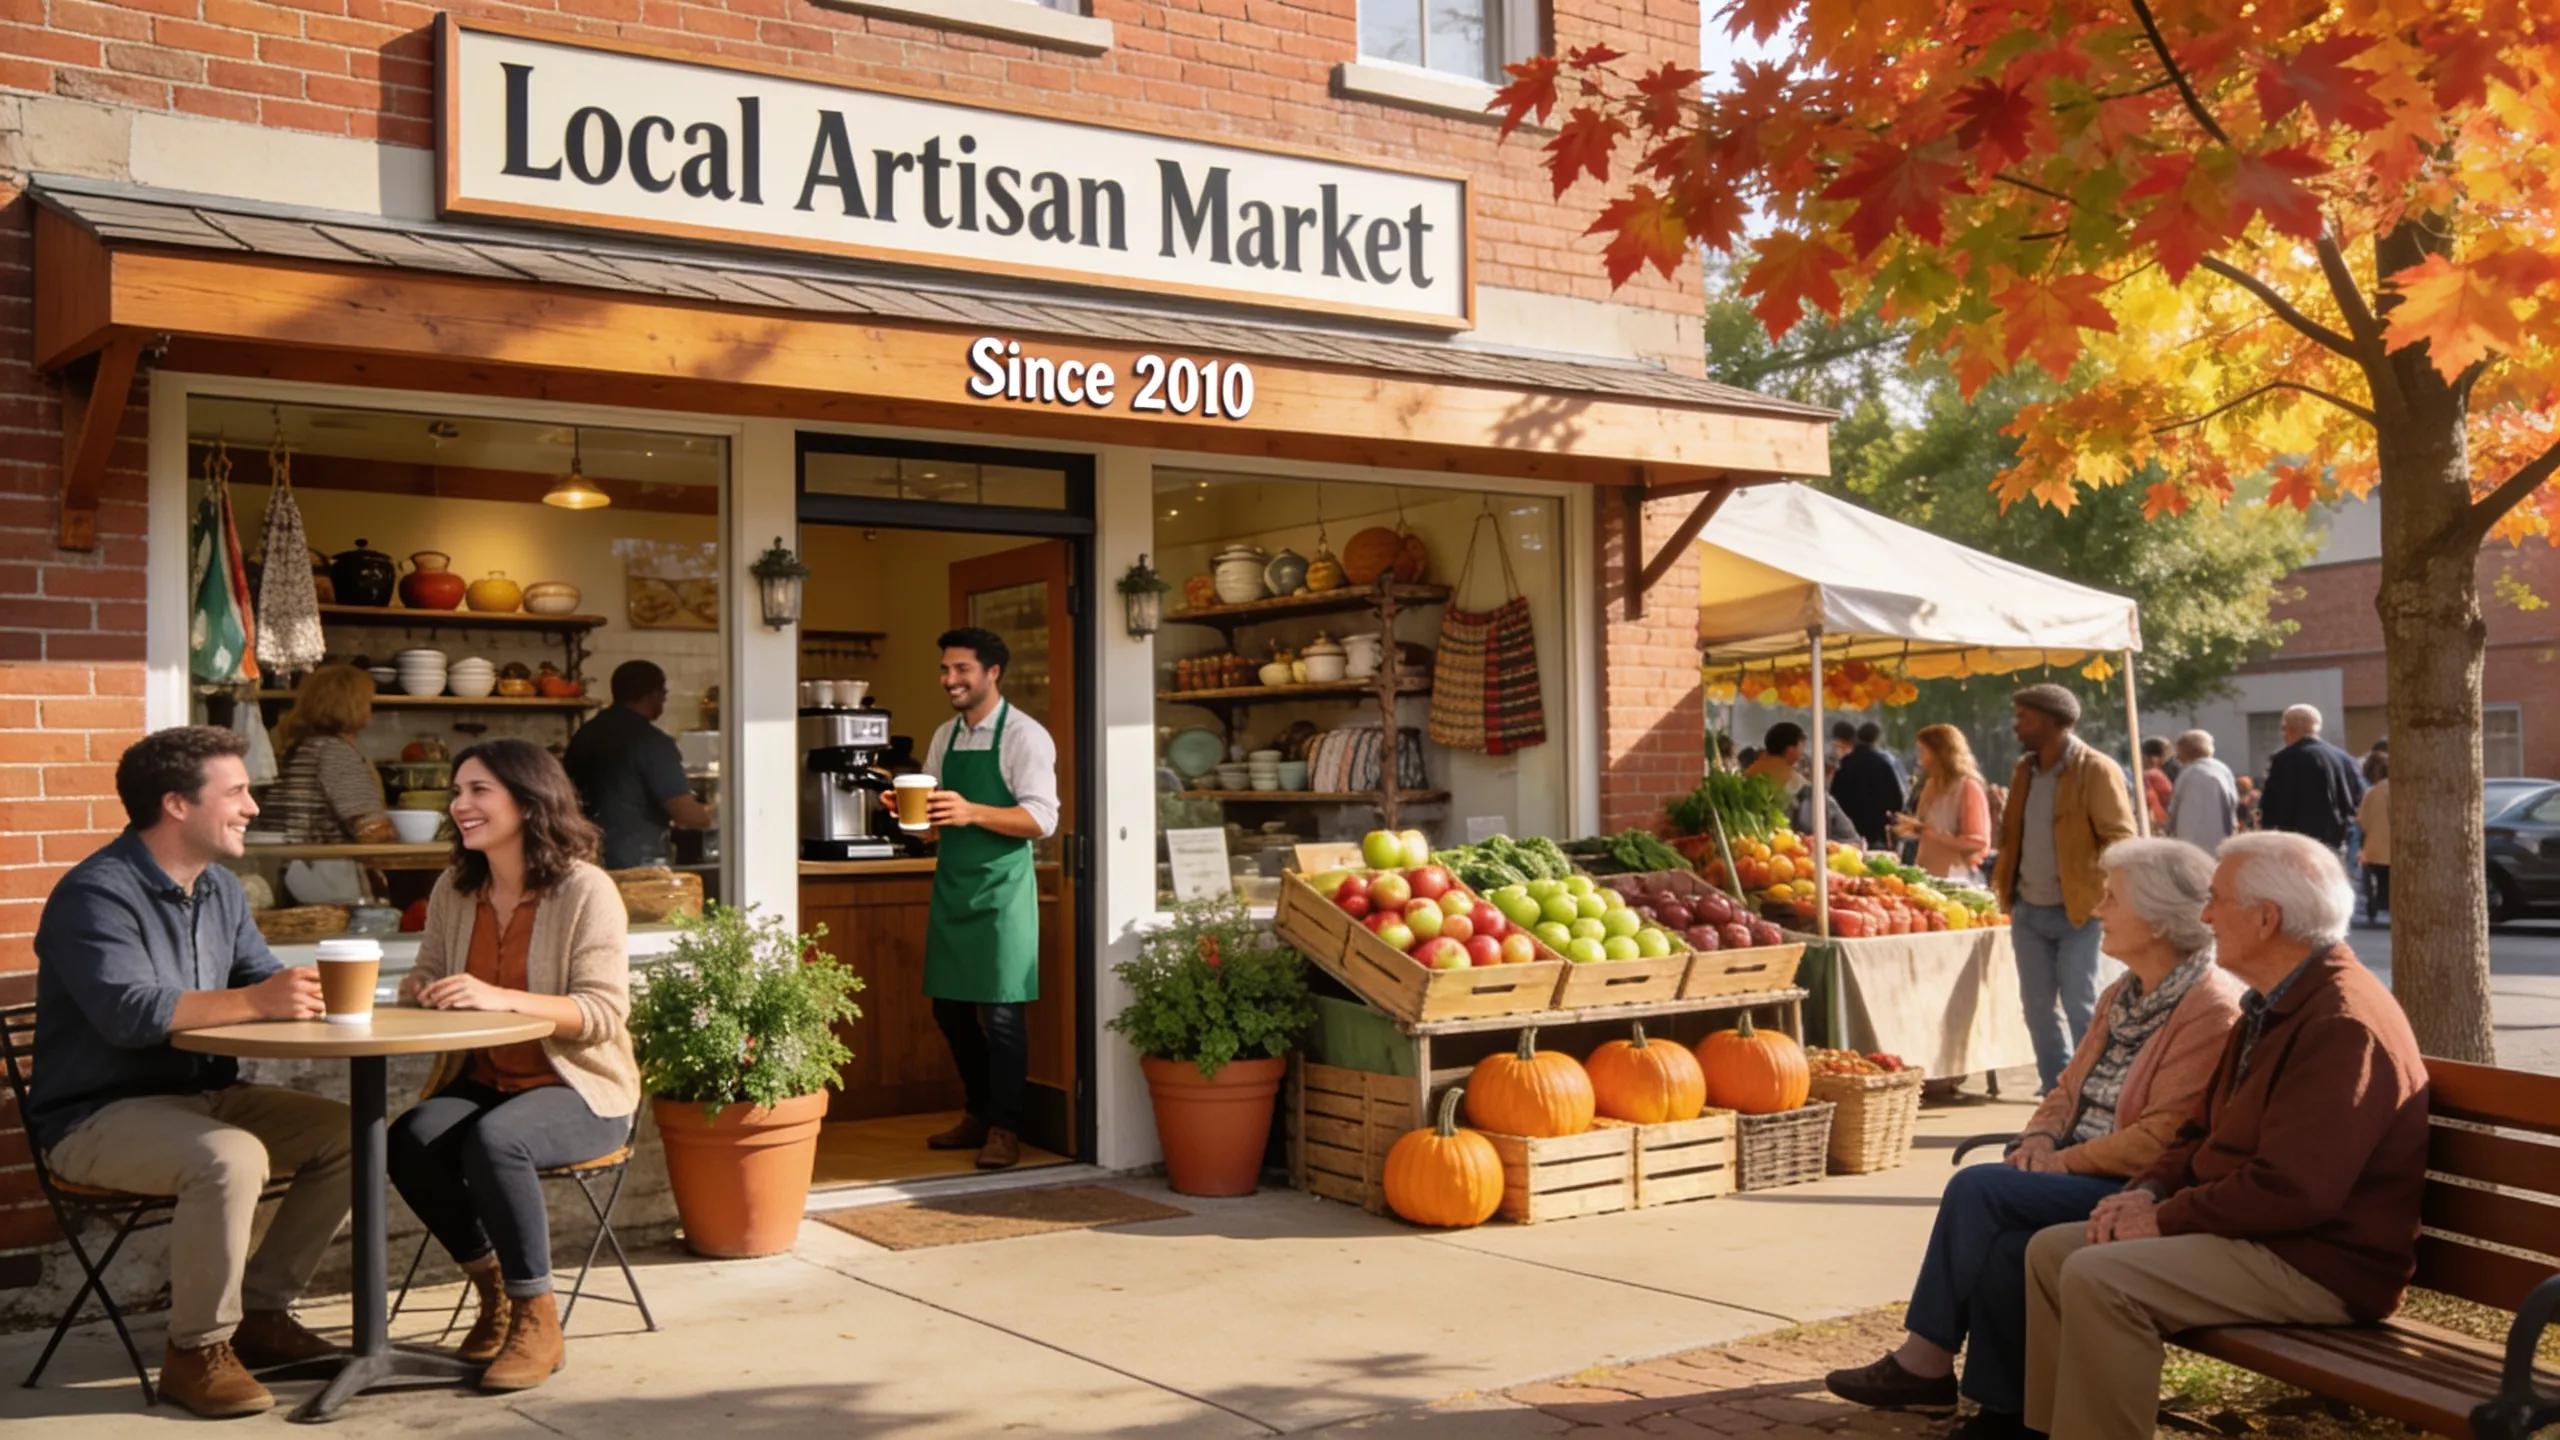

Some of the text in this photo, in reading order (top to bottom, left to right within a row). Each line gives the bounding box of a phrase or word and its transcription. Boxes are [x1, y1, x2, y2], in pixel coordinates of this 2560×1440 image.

[499, 61, 1435, 289] Local Artisan Market
[969, 336, 1254, 420] Since 2010
